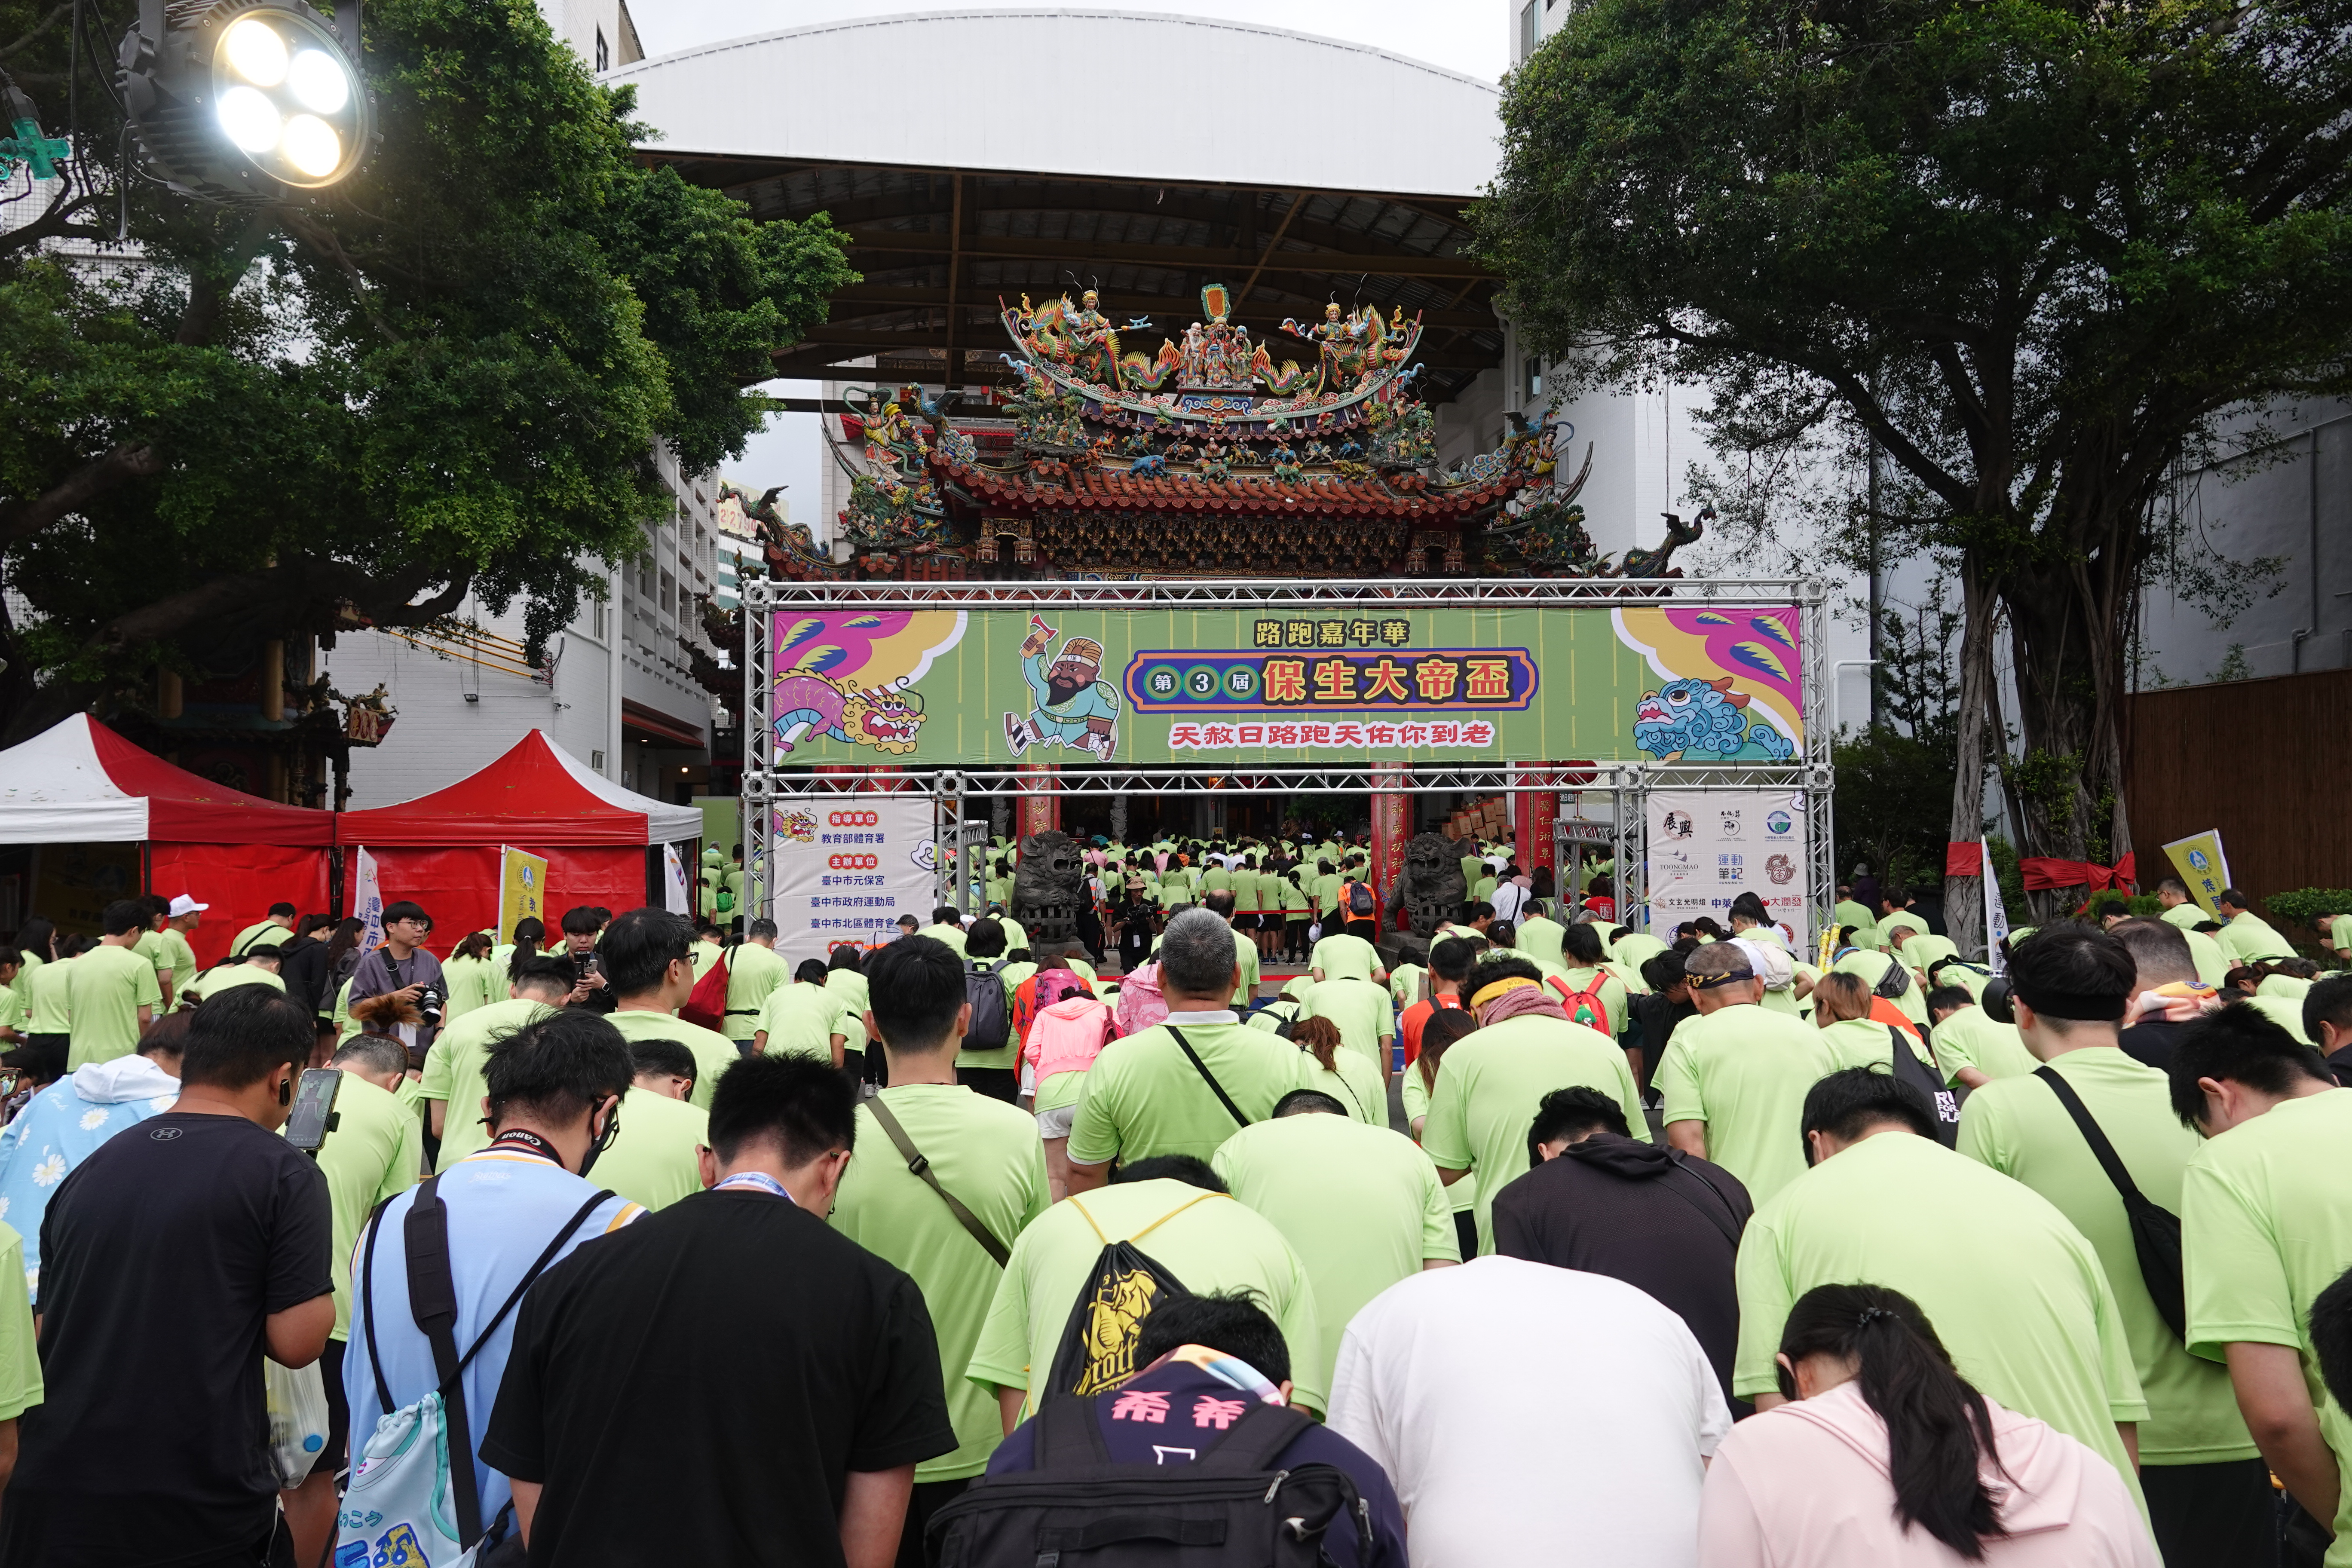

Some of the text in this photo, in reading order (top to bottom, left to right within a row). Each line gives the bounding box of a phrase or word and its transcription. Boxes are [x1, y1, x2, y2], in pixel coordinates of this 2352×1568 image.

[1256, 621, 1407, 645] 路跑嘉年華
[1155, 660, 1509, 701] 第3屆 保生大帝盃
[1172, 724, 1491, 745] 天赦日路跑天佑你到老
[831, 814, 876, 824] 指導單位
[1664, 813, 1693, 838] 展興
[821, 833, 885, 844] 教育部體育署
[831, 857, 875, 867] 主辦單位
[1718, 854, 1743, 866] 運動
[1718, 867, 1743, 879] 筆記
[821, 875, 885, 885] 臺中市元保宮
[811, 897, 895, 907] 臺中市政府運動局
[1669, 898, 1706, 906] 文玄光明燈
[1770, 897, 1801, 906] 大潤發
[811, 918, 895, 928] 臺中市北區體育會
[1937, 1104, 1960, 1112] FOR
[501, 1132, 542, 1146] Canon
[469, 1170, 511, 1181] Brothers
